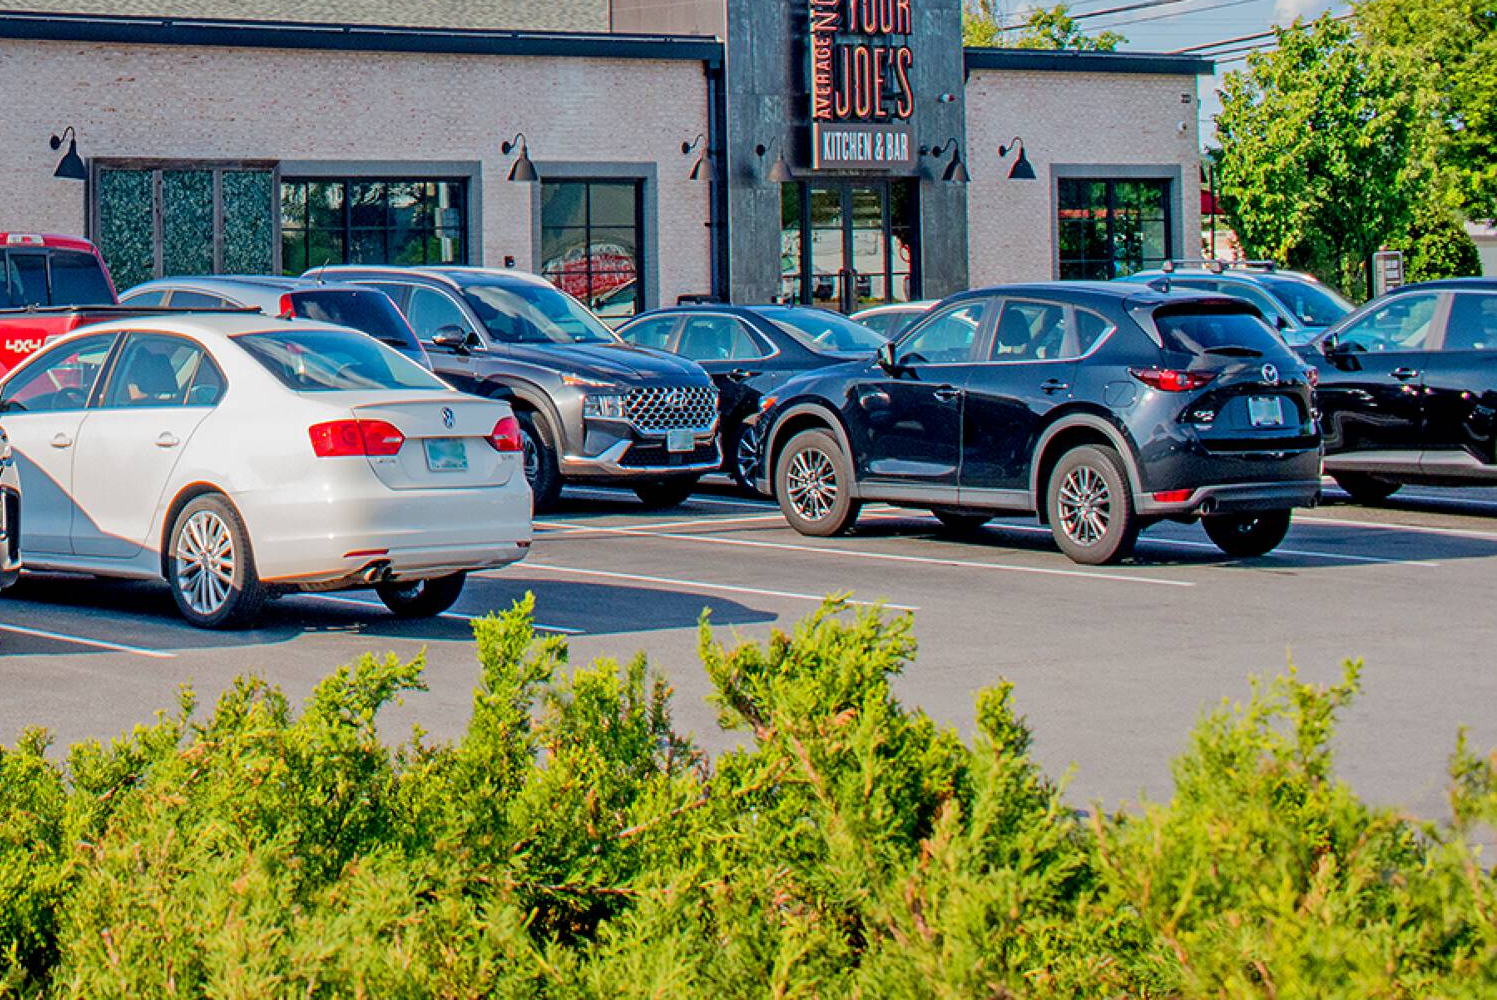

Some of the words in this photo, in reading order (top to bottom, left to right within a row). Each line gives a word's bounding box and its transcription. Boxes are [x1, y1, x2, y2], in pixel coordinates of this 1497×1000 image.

[814, 33, 832, 120] AVERAGE
[835, 46, 913, 120] JOE'S
[823, 131, 872, 161] KITCHEN
[875, 131, 884, 161] &
[886, 131, 909, 161] BAR
